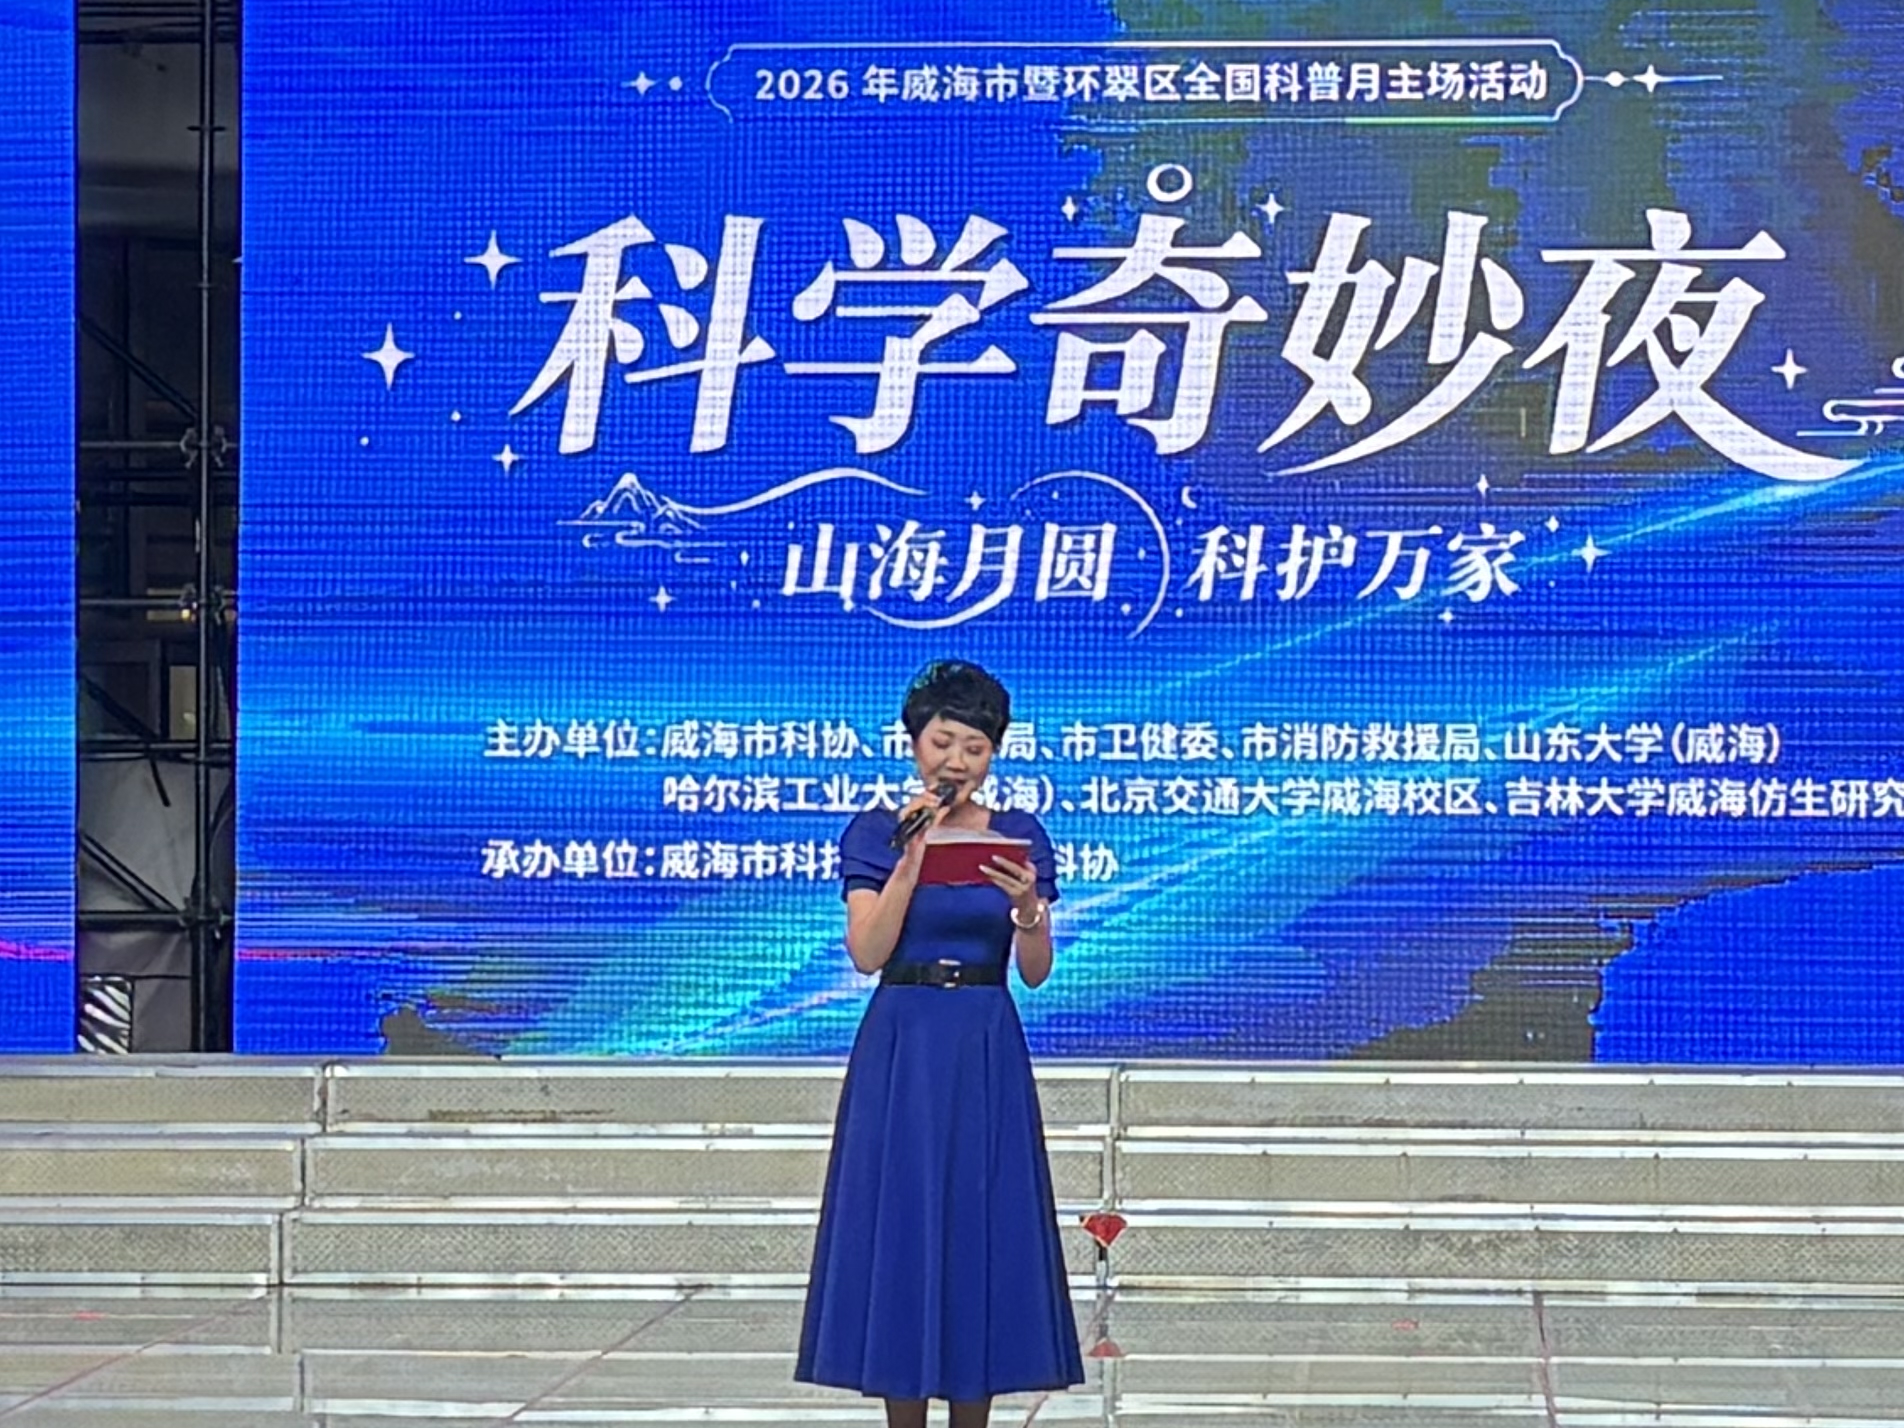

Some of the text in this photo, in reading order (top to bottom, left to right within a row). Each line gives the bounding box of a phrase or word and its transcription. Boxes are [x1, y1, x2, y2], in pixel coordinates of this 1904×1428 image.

[755, 61, 1549, 105] 2026 年威海市暨环翠区全国科普月主场活动
[510, 207, 1868, 482] 科学奇妙夜
[781, 520, 1527, 604] 山海月圆 科护万家
[483, 720, 1781, 764] 主办单位：威海市科协、市局、市卫健委、市消防救援局、山东大学（威海）
